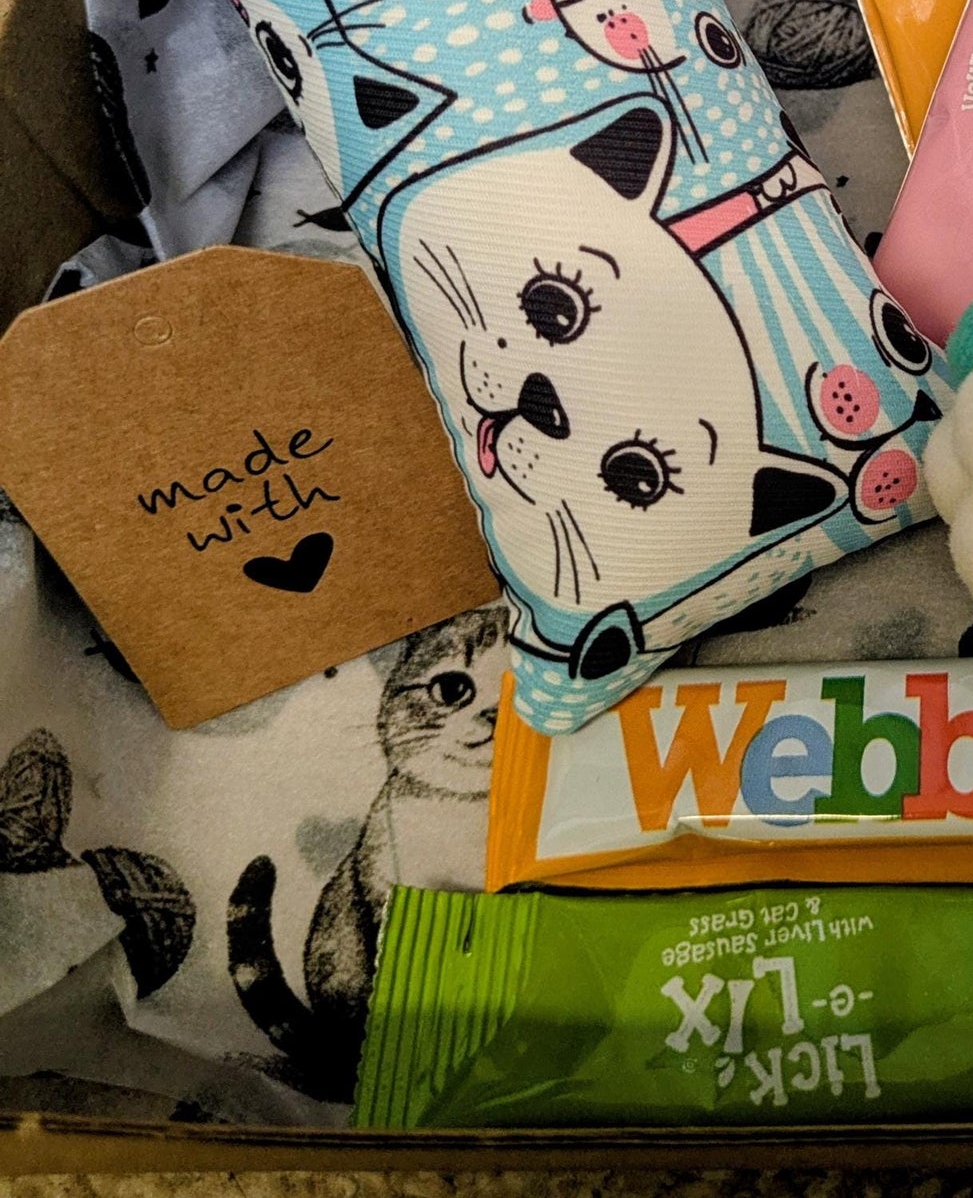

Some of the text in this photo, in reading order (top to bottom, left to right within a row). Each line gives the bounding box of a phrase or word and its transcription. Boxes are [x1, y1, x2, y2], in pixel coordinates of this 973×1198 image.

[138, 427, 334, 514] made
[187, 473, 340, 551] with
[662, 916, 874, 966] with Liver Sausage
[689, 896, 820, 936] & Cat Grass
